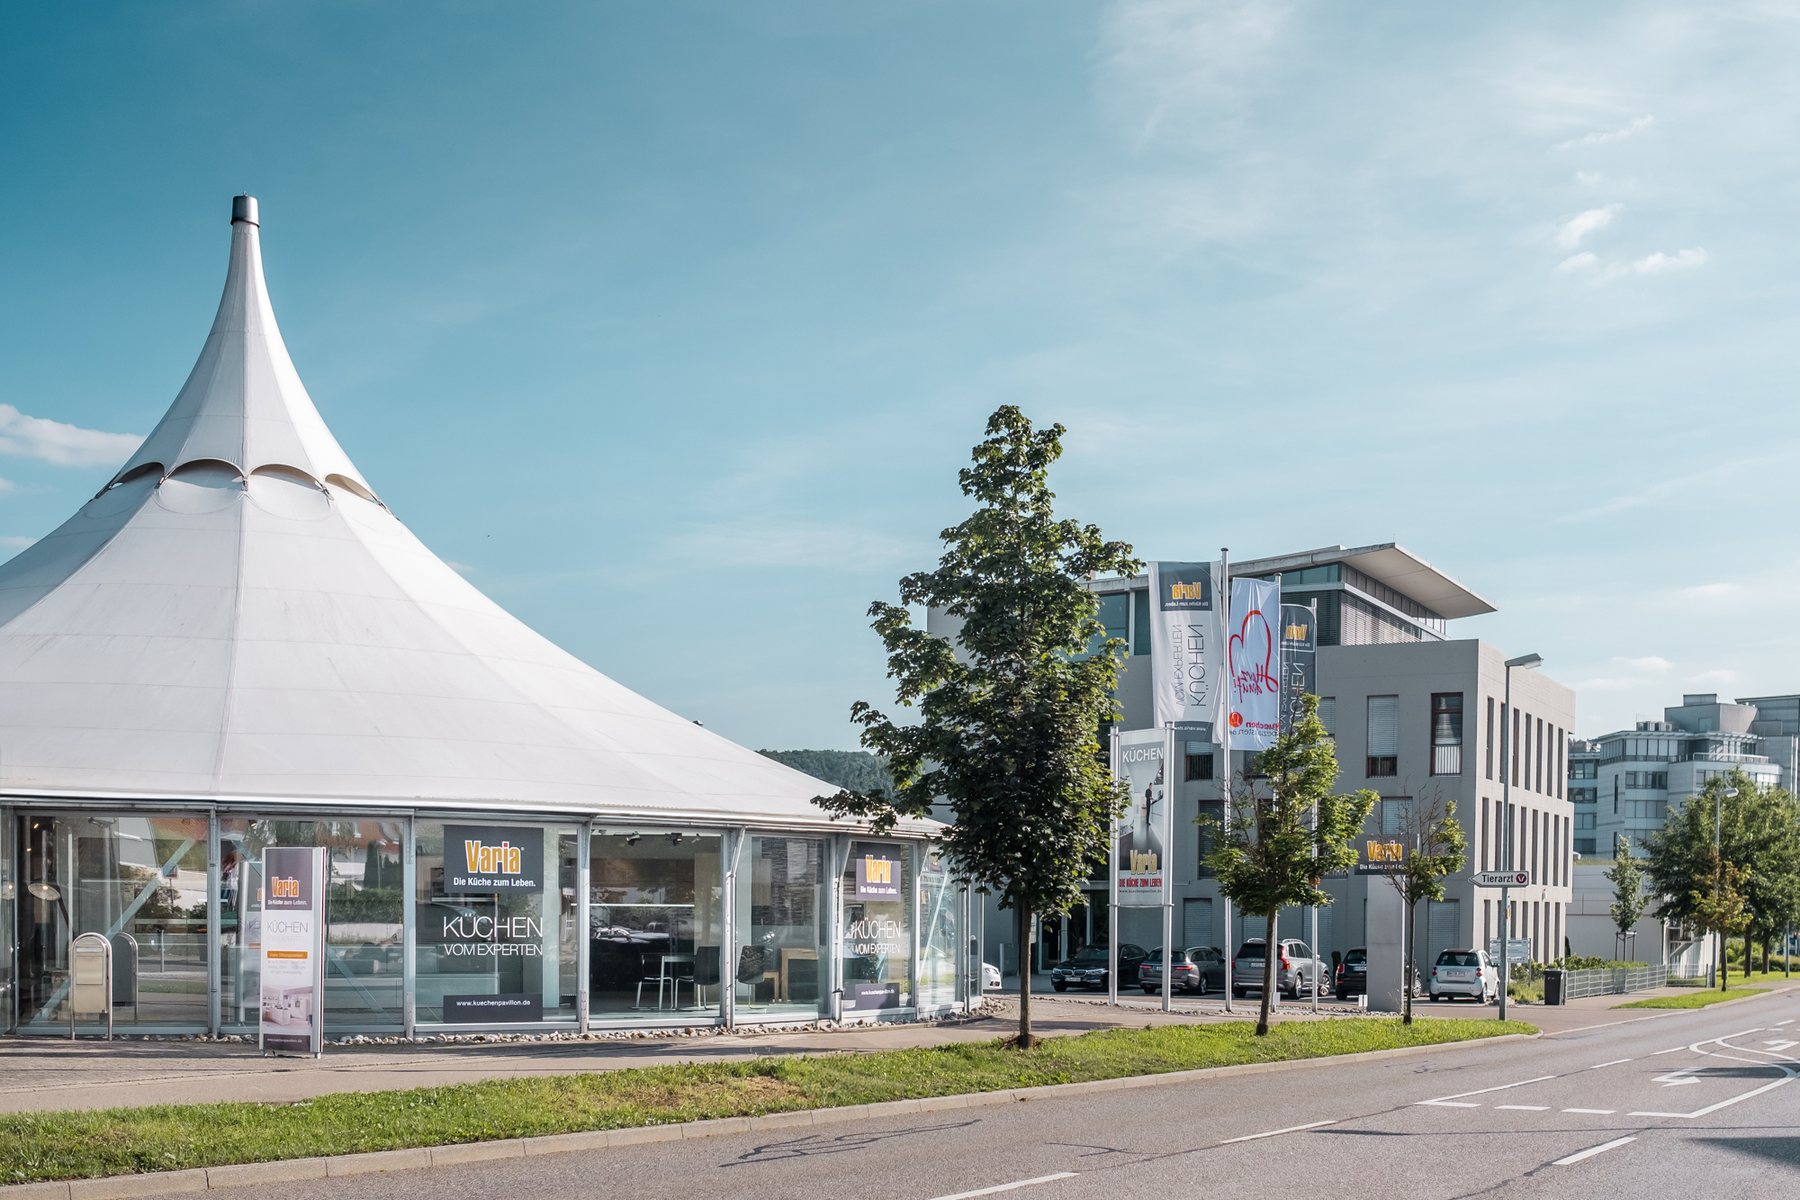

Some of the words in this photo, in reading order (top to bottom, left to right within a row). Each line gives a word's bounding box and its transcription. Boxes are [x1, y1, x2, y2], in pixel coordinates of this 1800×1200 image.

[1122, 747, 1164, 763] KÜCHEN
[464, 840, 522, 875] Varia
[1130, 848, 1158, 875] Varia
[865, 854, 892, 884] Varia
[1482, 874, 1514, 883] Tierarzt
[271, 876, 300, 898] Varia
[453, 877, 466, 886] Die
[468, 877, 492, 887] Küche
[493, 879, 510, 887] zum
[511, 878, 536, 887] Leben.
[266, 919, 309, 934] KÜCHEN
[443, 913, 543, 938] KÜCHEN
[854, 917, 901, 939] KÜCHEN
[443, 943, 476, 956] VOM
[477, 943, 543, 956] EXPERTEN
[456, 999, 531, 1007] www.kuechenpavillon.de
